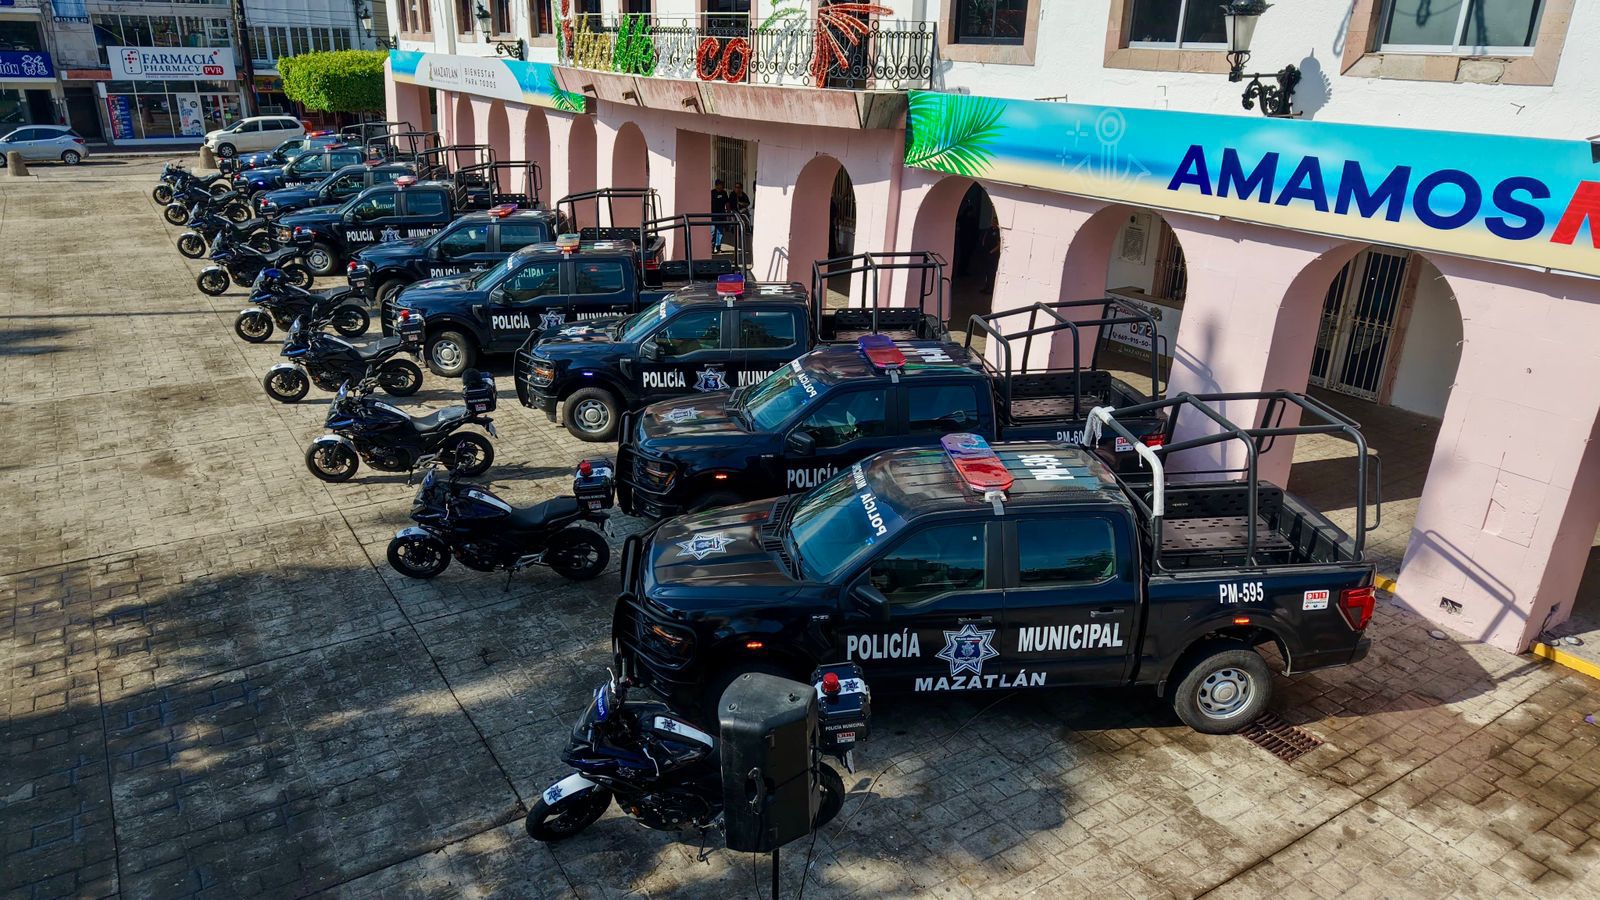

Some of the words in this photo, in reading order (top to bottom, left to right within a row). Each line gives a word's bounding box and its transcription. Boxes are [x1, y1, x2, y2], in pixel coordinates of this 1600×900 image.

[142, 53, 216, 65] FARMACIA
[204, 66, 223, 74] PVR
[346, 228, 375, 242] POLICÍA
[492, 312, 531, 330] POLICÍA
[642, 368, 686, 388] POLICÍA
[1056, 430, 1084, 444] PM-60
[1219, 582, 1264, 604] PM-595
[847, 628, 921, 660] POLICÍA
[1018, 622, 1123, 652] MUNICIPAL
[915, 668, 1047, 692] MAZATLÁN
